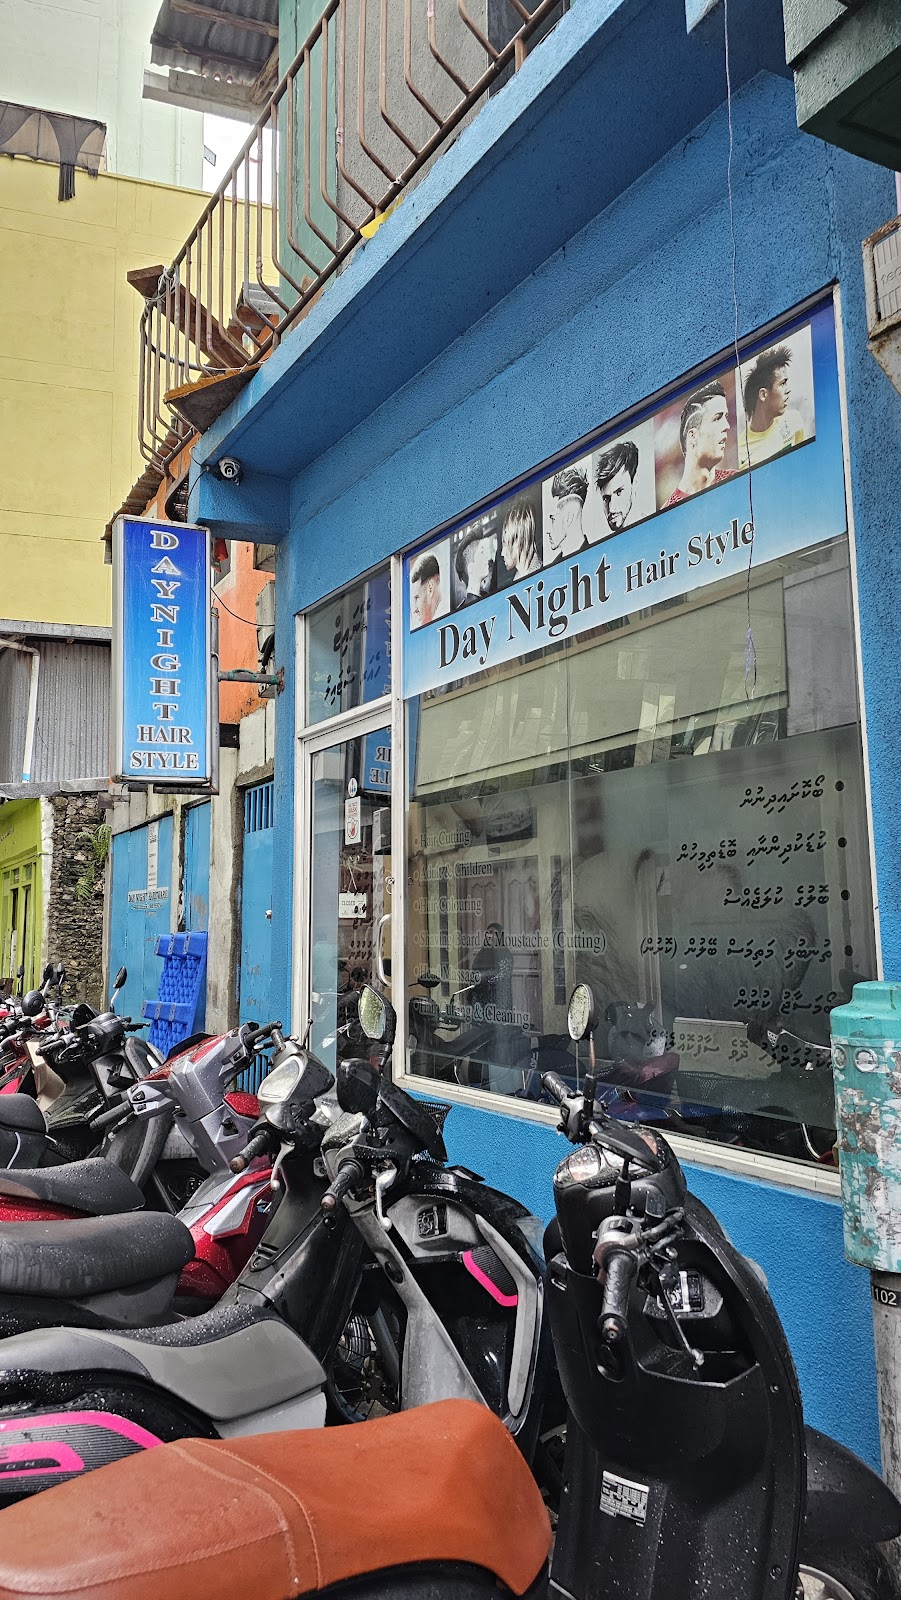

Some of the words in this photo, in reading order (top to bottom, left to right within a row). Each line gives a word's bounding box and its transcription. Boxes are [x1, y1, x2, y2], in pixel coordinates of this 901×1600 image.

[437, 615, 498, 670] Day
[506, 553, 612, 642] Night
[624, 549, 681, 595] Hair
[687, 516, 756, 570] Style
[137, 724, 193, 745] HAIR
[130, 751, 199, 770] STYLE
[420, 833, 438, 849] Hair
[439, 829, 471, 846] Cutting
[454, 861, 493, 878] Children
[438, 894, 483, 916] Colouring
[455, 930, 481, 947] Beard
[482, 931, 493, 948] &
[494, 930, 550, 948] Moustache
[552, 929, 606, 954] (Cutting)
[441, 963, 481, 984] Massage
[420, 1002, 440, 1015] Hair
[474, 1002, 483, 1021] &
[484, 1003, 530, 1029] Cleaning
